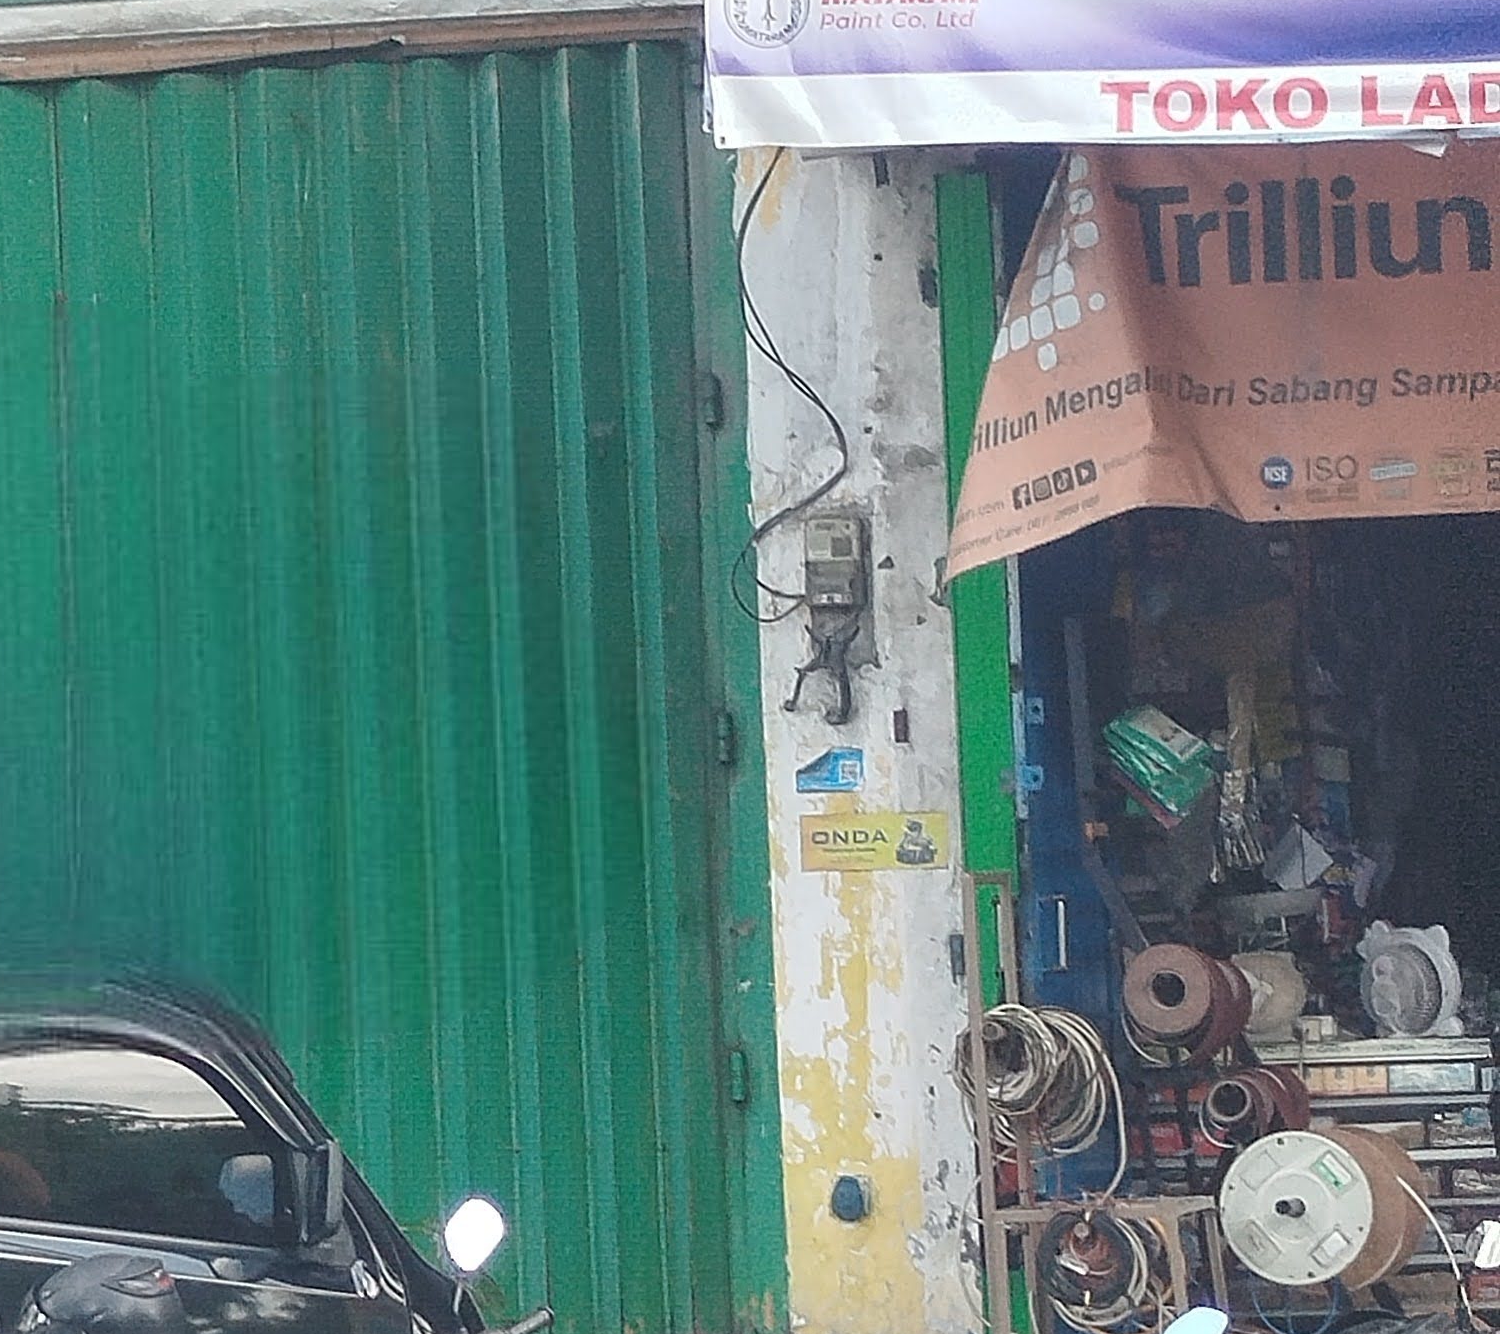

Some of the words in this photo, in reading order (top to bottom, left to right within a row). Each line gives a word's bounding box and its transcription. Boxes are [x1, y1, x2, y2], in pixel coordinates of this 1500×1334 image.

[820, 11, 883, 30] Paint
[936, 9, 975, 28] Ltd
[1100, 76, 1330, 133] TOKO
[1114, 175, 1493, 287] Trilliun
[1248, 375, 1378, 407] Sabang
[1306, 454, 1357, 482] ISO
[811, 829, 889, 845] ONDA
